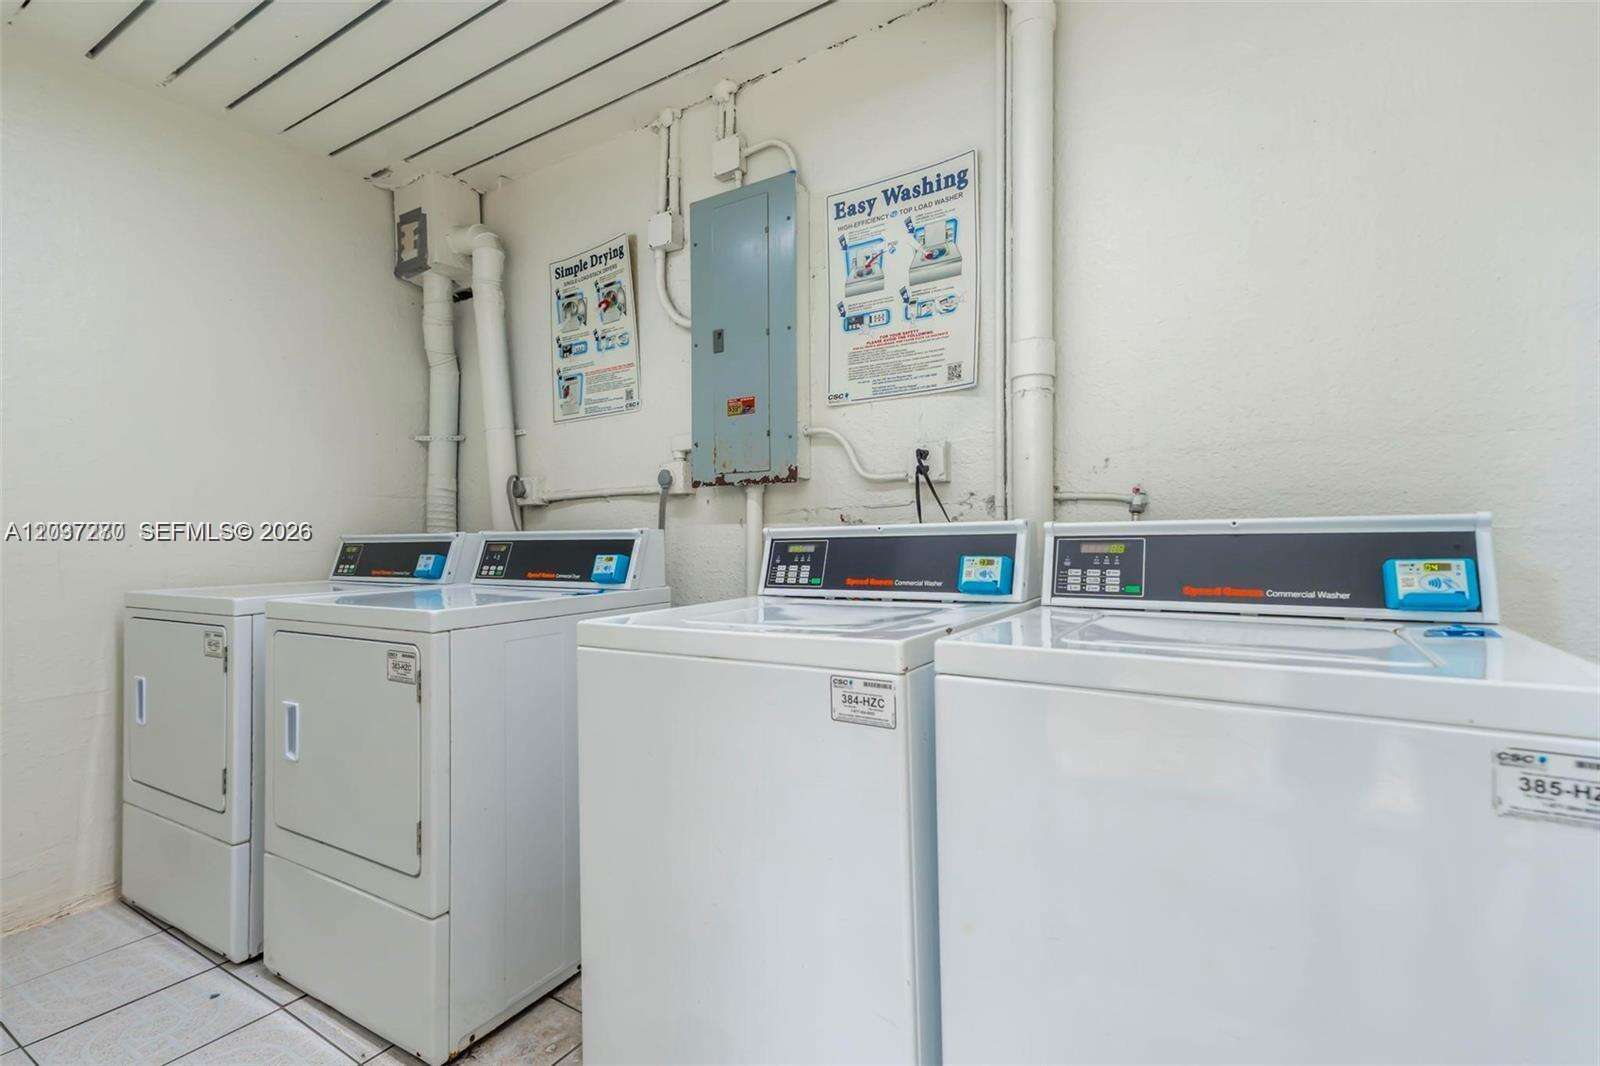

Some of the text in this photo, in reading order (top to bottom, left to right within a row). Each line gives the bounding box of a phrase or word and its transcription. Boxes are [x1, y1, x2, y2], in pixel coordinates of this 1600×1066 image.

[834, 168, 969, 220] Easy Washing
[900, 206, 913, 215] TOP
[914, 201, 933, 211] LOAD
[934, 192, 964, 206] WASHER
[555, 259, 588, 280] Simple
[590, 245, 625, 268] Drying
[1265, 588, 1316, 599] Commercial
[1317, 590, 1351, 600] Washer
[841, 693, 885, 709] 384-HZC
